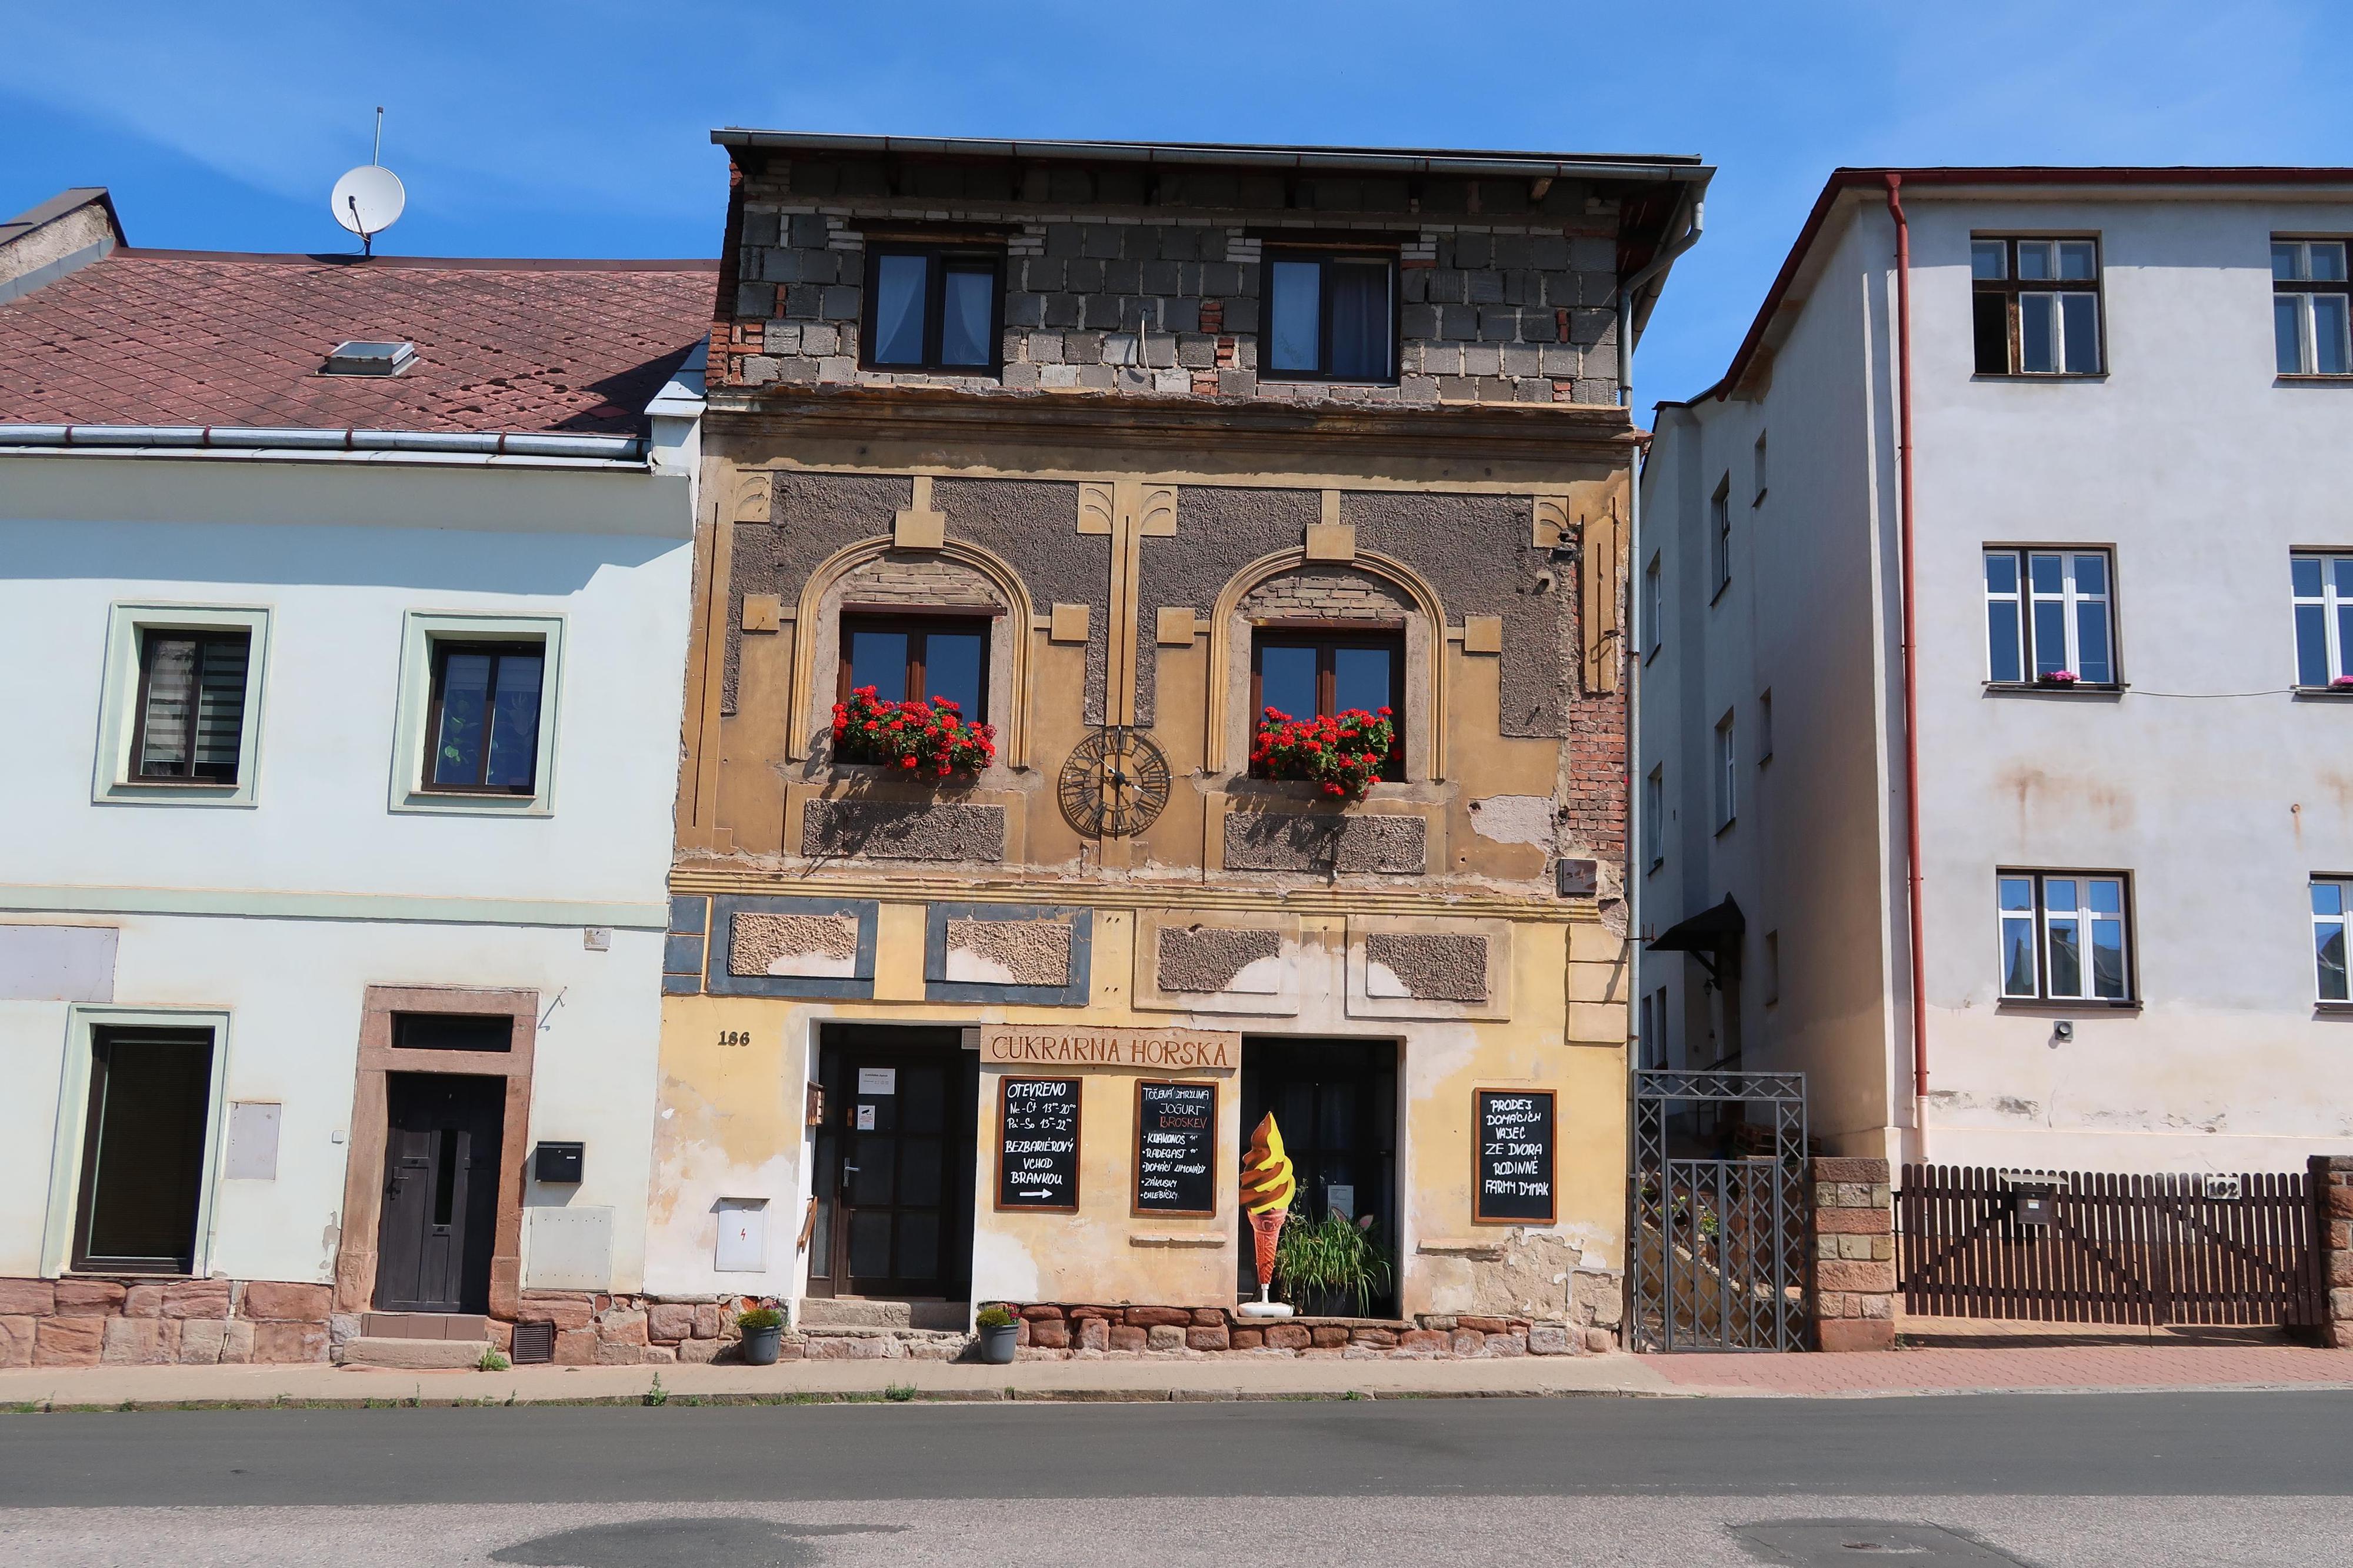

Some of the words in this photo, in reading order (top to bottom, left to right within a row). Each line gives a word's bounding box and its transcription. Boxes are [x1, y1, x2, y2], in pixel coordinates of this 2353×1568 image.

[718, 1030, 750, 1047] 186
[992, 1034, 1121, 1062] CUKRÁRNA
[1132, 1039, 1228, 1066] HORSKÁ
[1007, 1082, 1066, 1098] OTEVŘENO
[1159, 1103, 1205, 1116] JOGURT
[1490, 1099, 1533, 1113] PRODEJ
[1159, 1116, 1208, 1129] BROSKEV
[1486, 1110, 1542, 1126] DOMÁCÍCH
[1495, 1126, 1526, 1140] VAJEC
[1005, 1136, 1074, 1153] BEZBARIÉROVÝ
[1485, 1143, 1504, 1155] ZE
[1508, 1143, 1542, 1156] DVORA
[1145, 1147, 1187, 1159] RADEGAST
[1023, 1157, 1053, 1170] VCHOD
[1144, 1160, 1172, 1172] DOMÁCÍ
[1174, 1163, 1206, 1175] LIMONÁDY
[1492, 1155, 1538, 1176] RODINNÉ
[1010, 1171, 1063, 1185] BRANKOU
[1144, 1176, 1177, 1187] ZÁKUSKY
[1485, 1179, 1516, 1195] FARMY
[1518, 1181, 1549, 1196] DYMAK
[2208, 1182, 2238, 1196] 182
